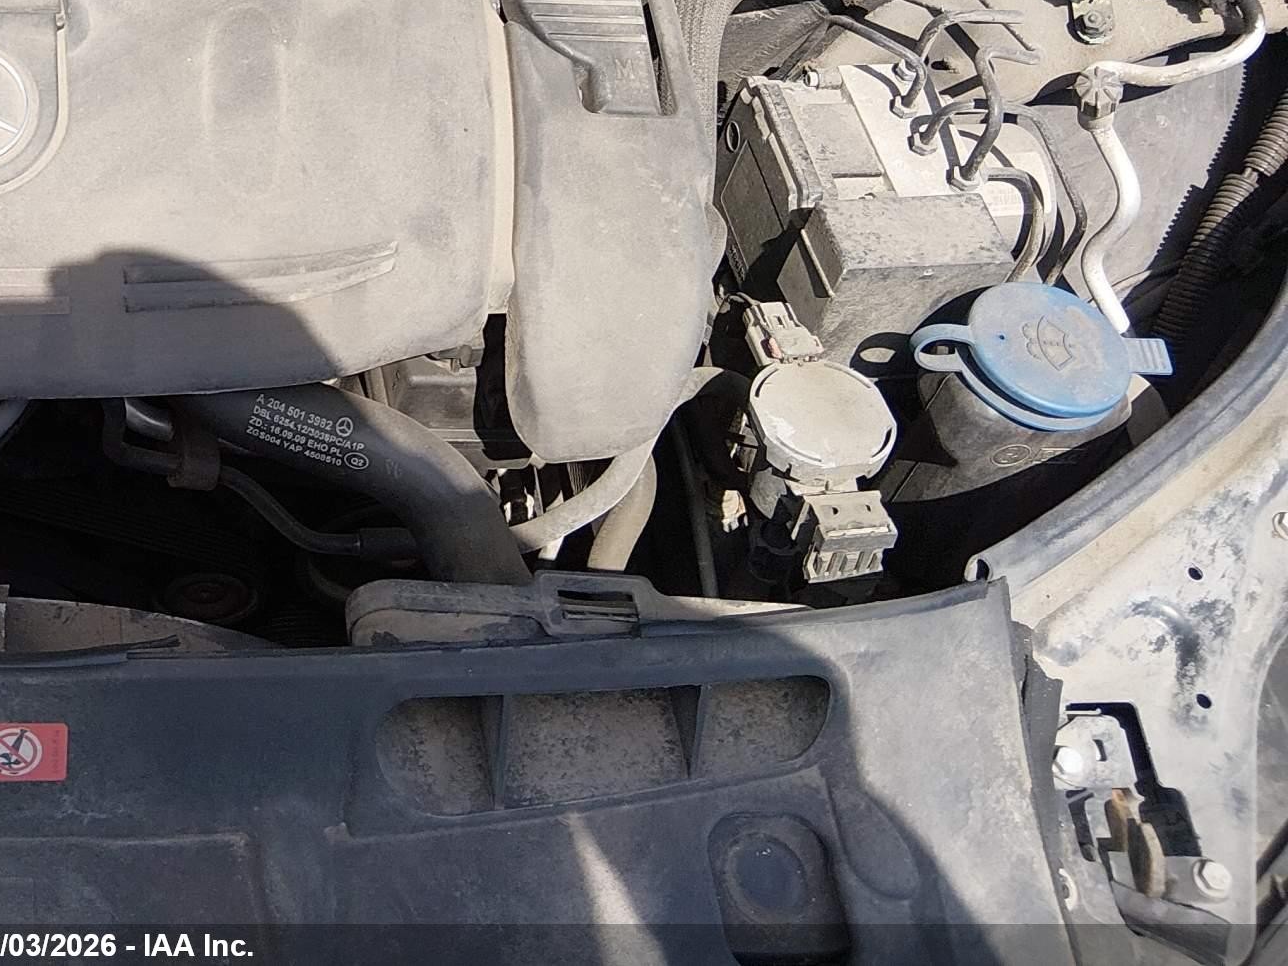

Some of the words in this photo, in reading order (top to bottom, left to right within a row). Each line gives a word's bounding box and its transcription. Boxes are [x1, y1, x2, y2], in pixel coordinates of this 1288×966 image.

[253, 405, 272, 421] DBL
[256, 393, 265, 405] A
[267, 397, 286, 413] 204
[287, 406, 306, 421] 501
[307, 413, 333, 431] 3982
[246, 425, 281, 446] ZGS004
[283, 440, 303, 453] YAP
[307, 439, 329, 452] EHO
[330, 446, 343, 457] PL
[350, 457, 364, 467] Q2
